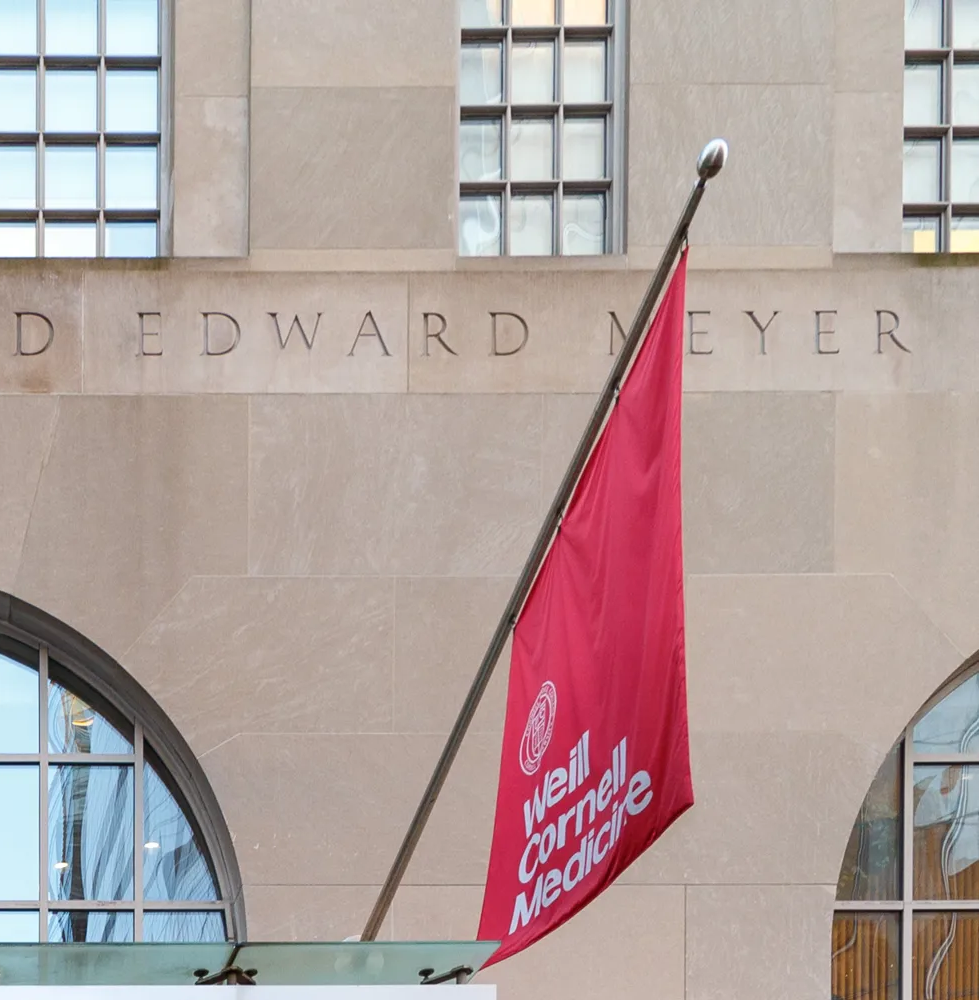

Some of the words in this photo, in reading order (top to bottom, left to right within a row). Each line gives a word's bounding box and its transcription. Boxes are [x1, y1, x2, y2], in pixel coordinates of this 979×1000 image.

[135, 310, 531, 357] EDWARD
[518, 737, 627, 884] Cornell
[523, 730, 590, 839] Weill
